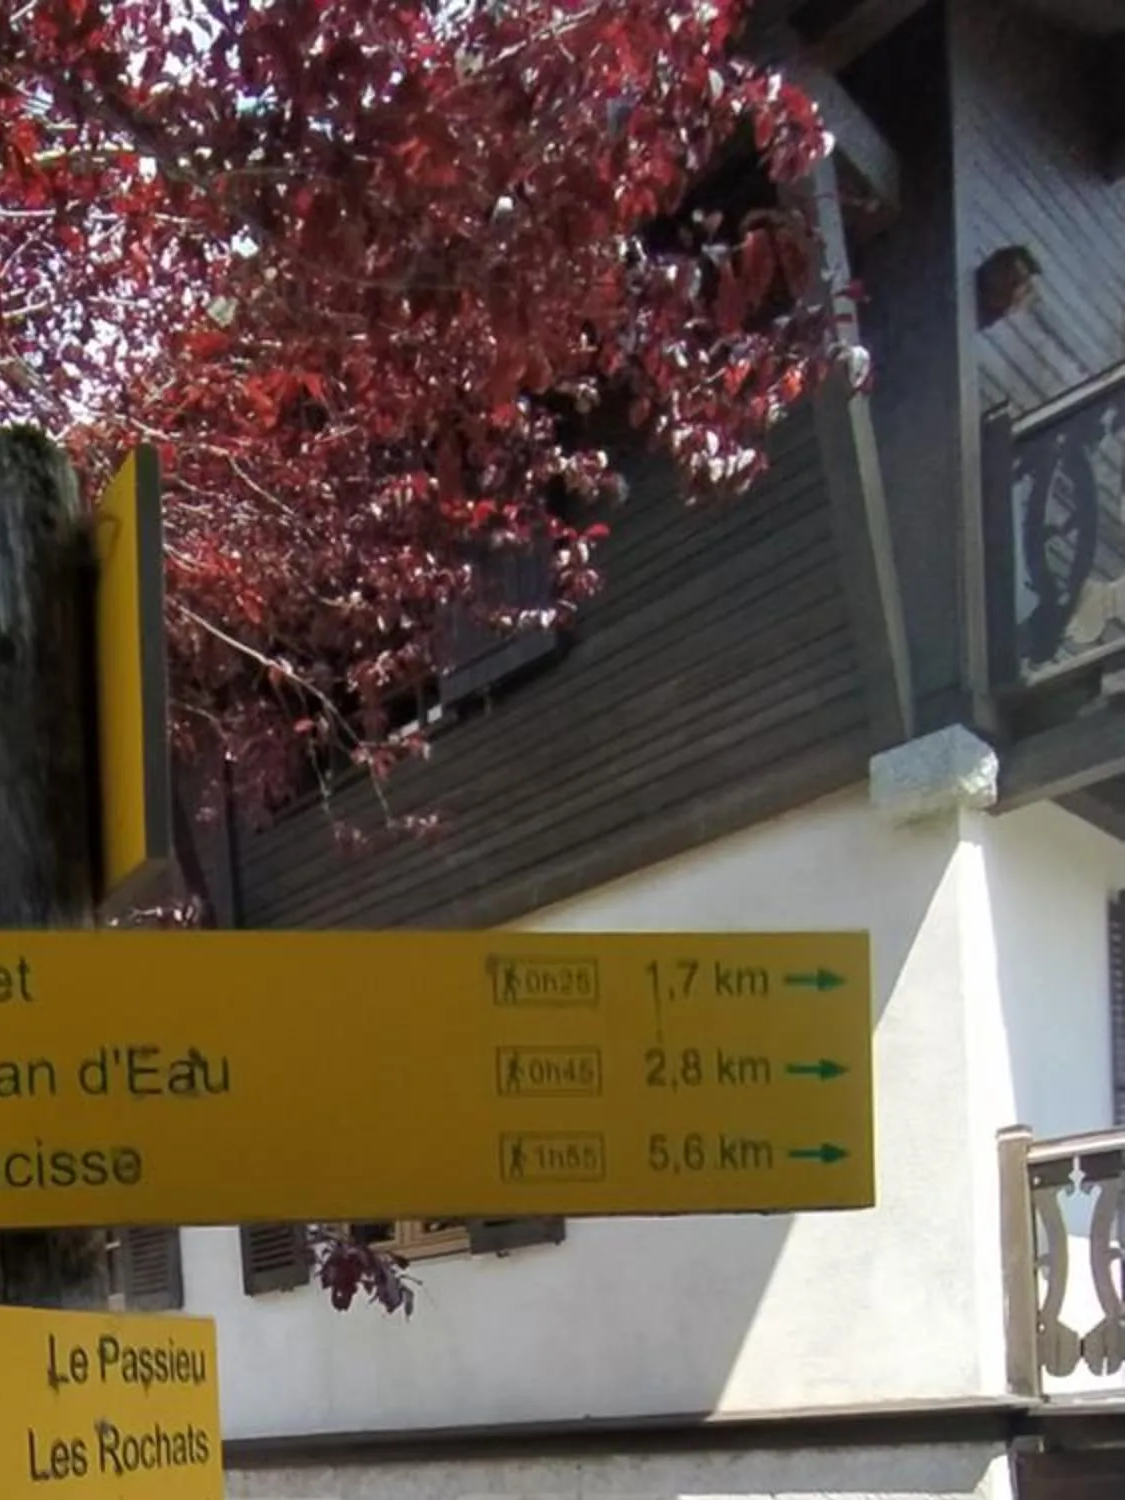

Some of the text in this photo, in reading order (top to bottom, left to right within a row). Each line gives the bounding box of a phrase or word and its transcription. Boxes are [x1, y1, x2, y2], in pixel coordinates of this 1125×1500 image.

[646, 961, 770, 1001] 1,7 km
[78, 1045, 230, 1095] d'Eau
[645, 1048, 772, 1092] 2,8 km
[648, 1133, 774, 1175] 5,6 km
[48, 1332, 206, 1390] Le Passieu
[28, 1421, 210, 1481] Les Rochats
